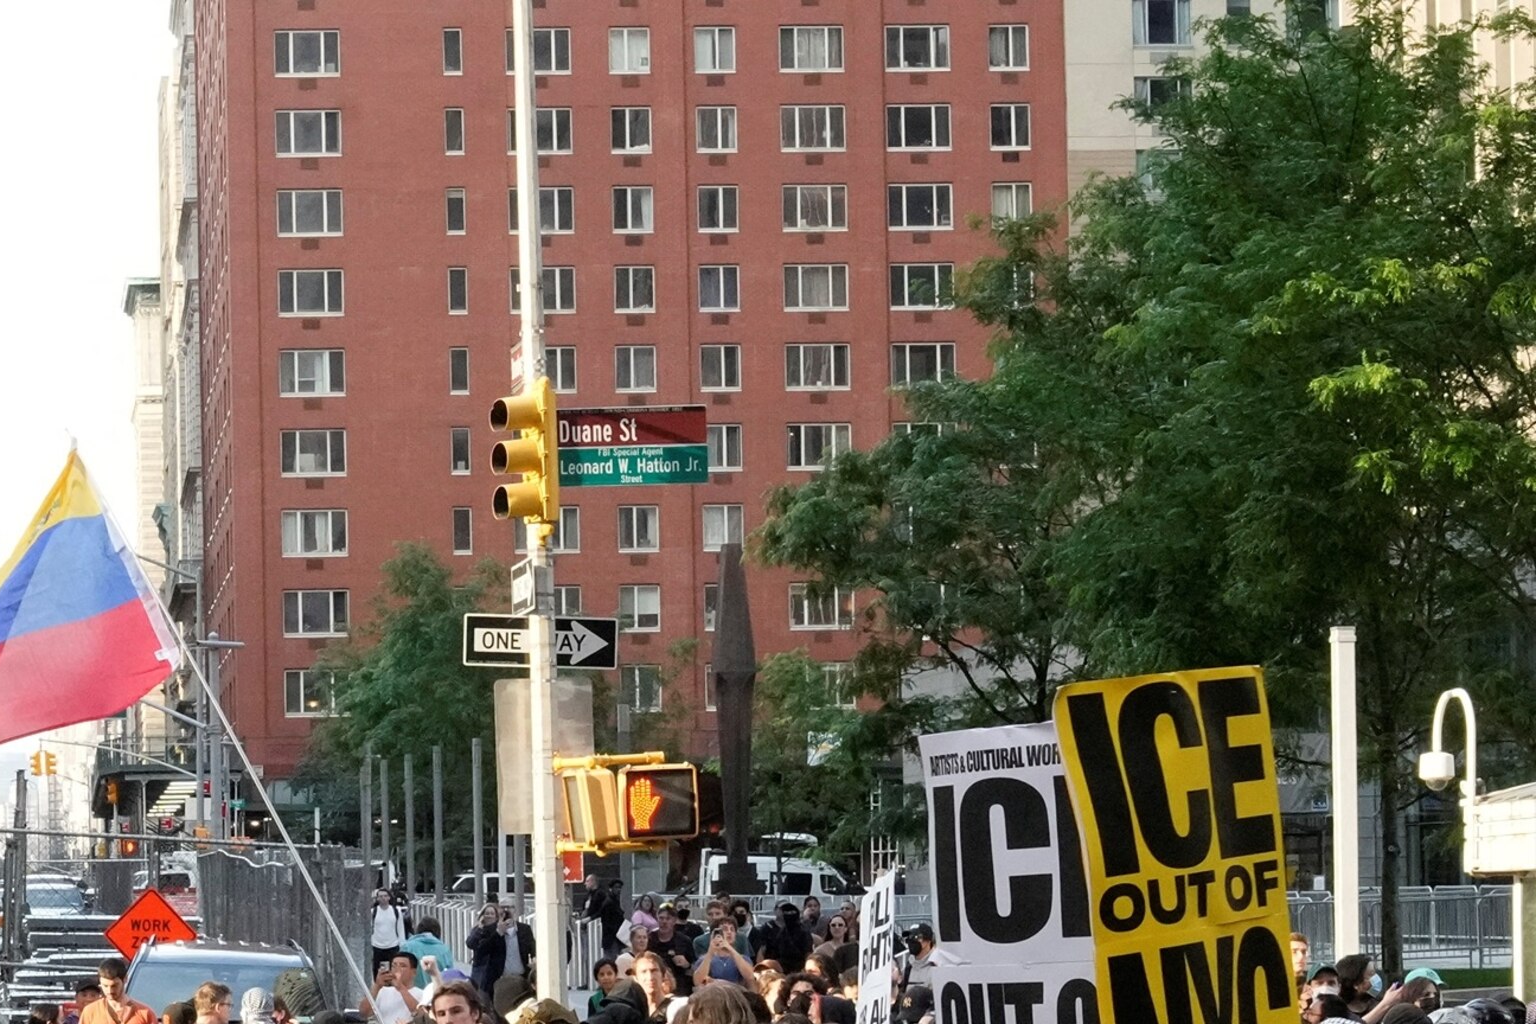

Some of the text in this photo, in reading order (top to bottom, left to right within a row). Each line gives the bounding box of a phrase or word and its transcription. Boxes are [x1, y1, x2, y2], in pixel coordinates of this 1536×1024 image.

[559, 418, 638, 443] Duane St
[598, 447, 664, 458] FBI Special Agent
[560, 457, 702, 475] Leonard W. Hatton Jr.
[620, 475, 643, 484] Street
[482, 631, 586, 652] ONE AY
[930, 753, 959, 777] ARTISTS
[966, 747, 1025, 773] CULTURAL
[1026, 743, 1061, 767] WOR
[1067, 676, 1277, 878] ICE
[1099, 859, 1279, 933] OUT OF
[130, 919, 171, 932] WORK
